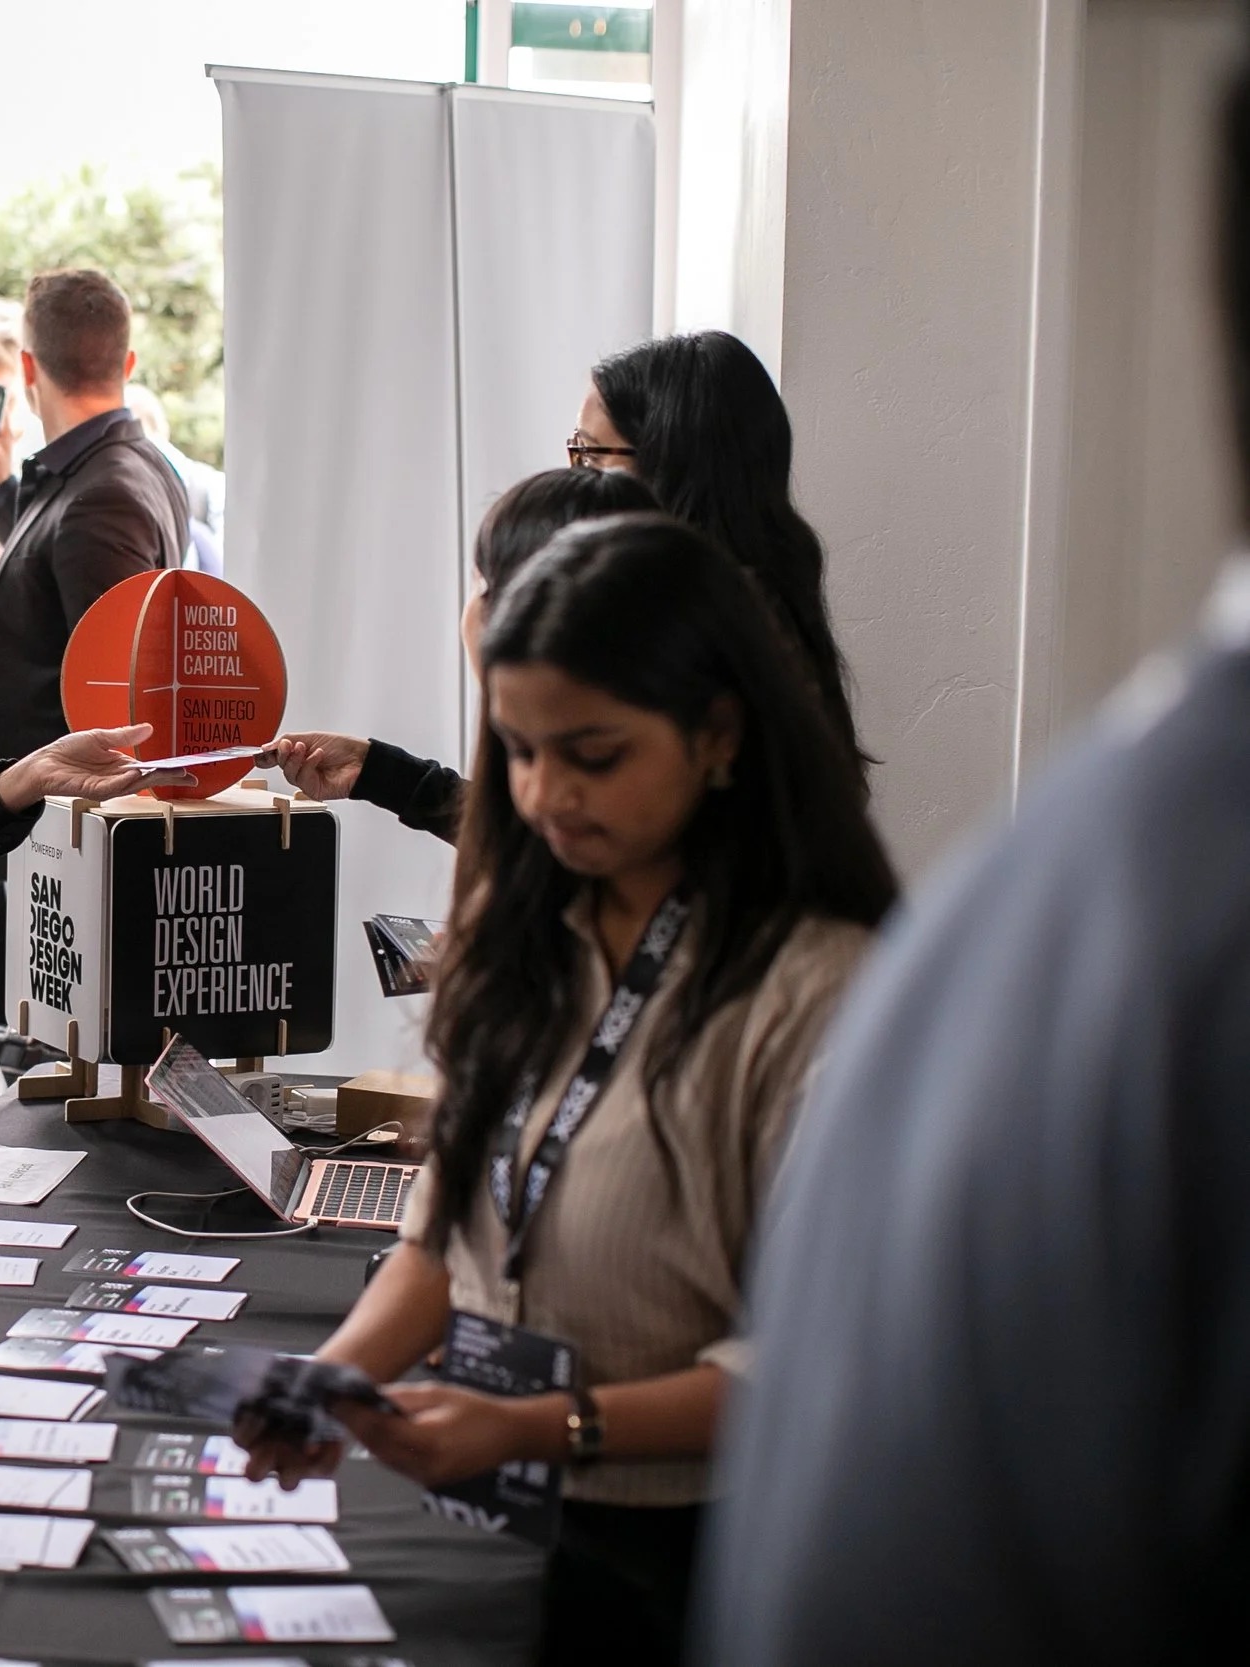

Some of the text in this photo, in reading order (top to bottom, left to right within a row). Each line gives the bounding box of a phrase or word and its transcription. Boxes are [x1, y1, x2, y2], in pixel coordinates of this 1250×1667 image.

[184, 606, 237, 627] WORLD
[184, 630, 238, 652] DESIGN
[184, 655, 244, 677] CAPITAL
[183, 698, 255, 721] SAN DIEGO
[183, 721, 242, 744] TIJUANA
[31, 840, 63, 860] POWERED BY
[31, 871, 62, 912] SAN
[153, 864, 245, 916] WORLD
[30, 903, 75, 948] DIEGO
[154, 914, 244, 967] DESIGN
[30, 935, 82, 985] DESIGN
[30, 967, 73, 1015] WEEK
[153, 962, 294, 1018] EXPERIENCE
